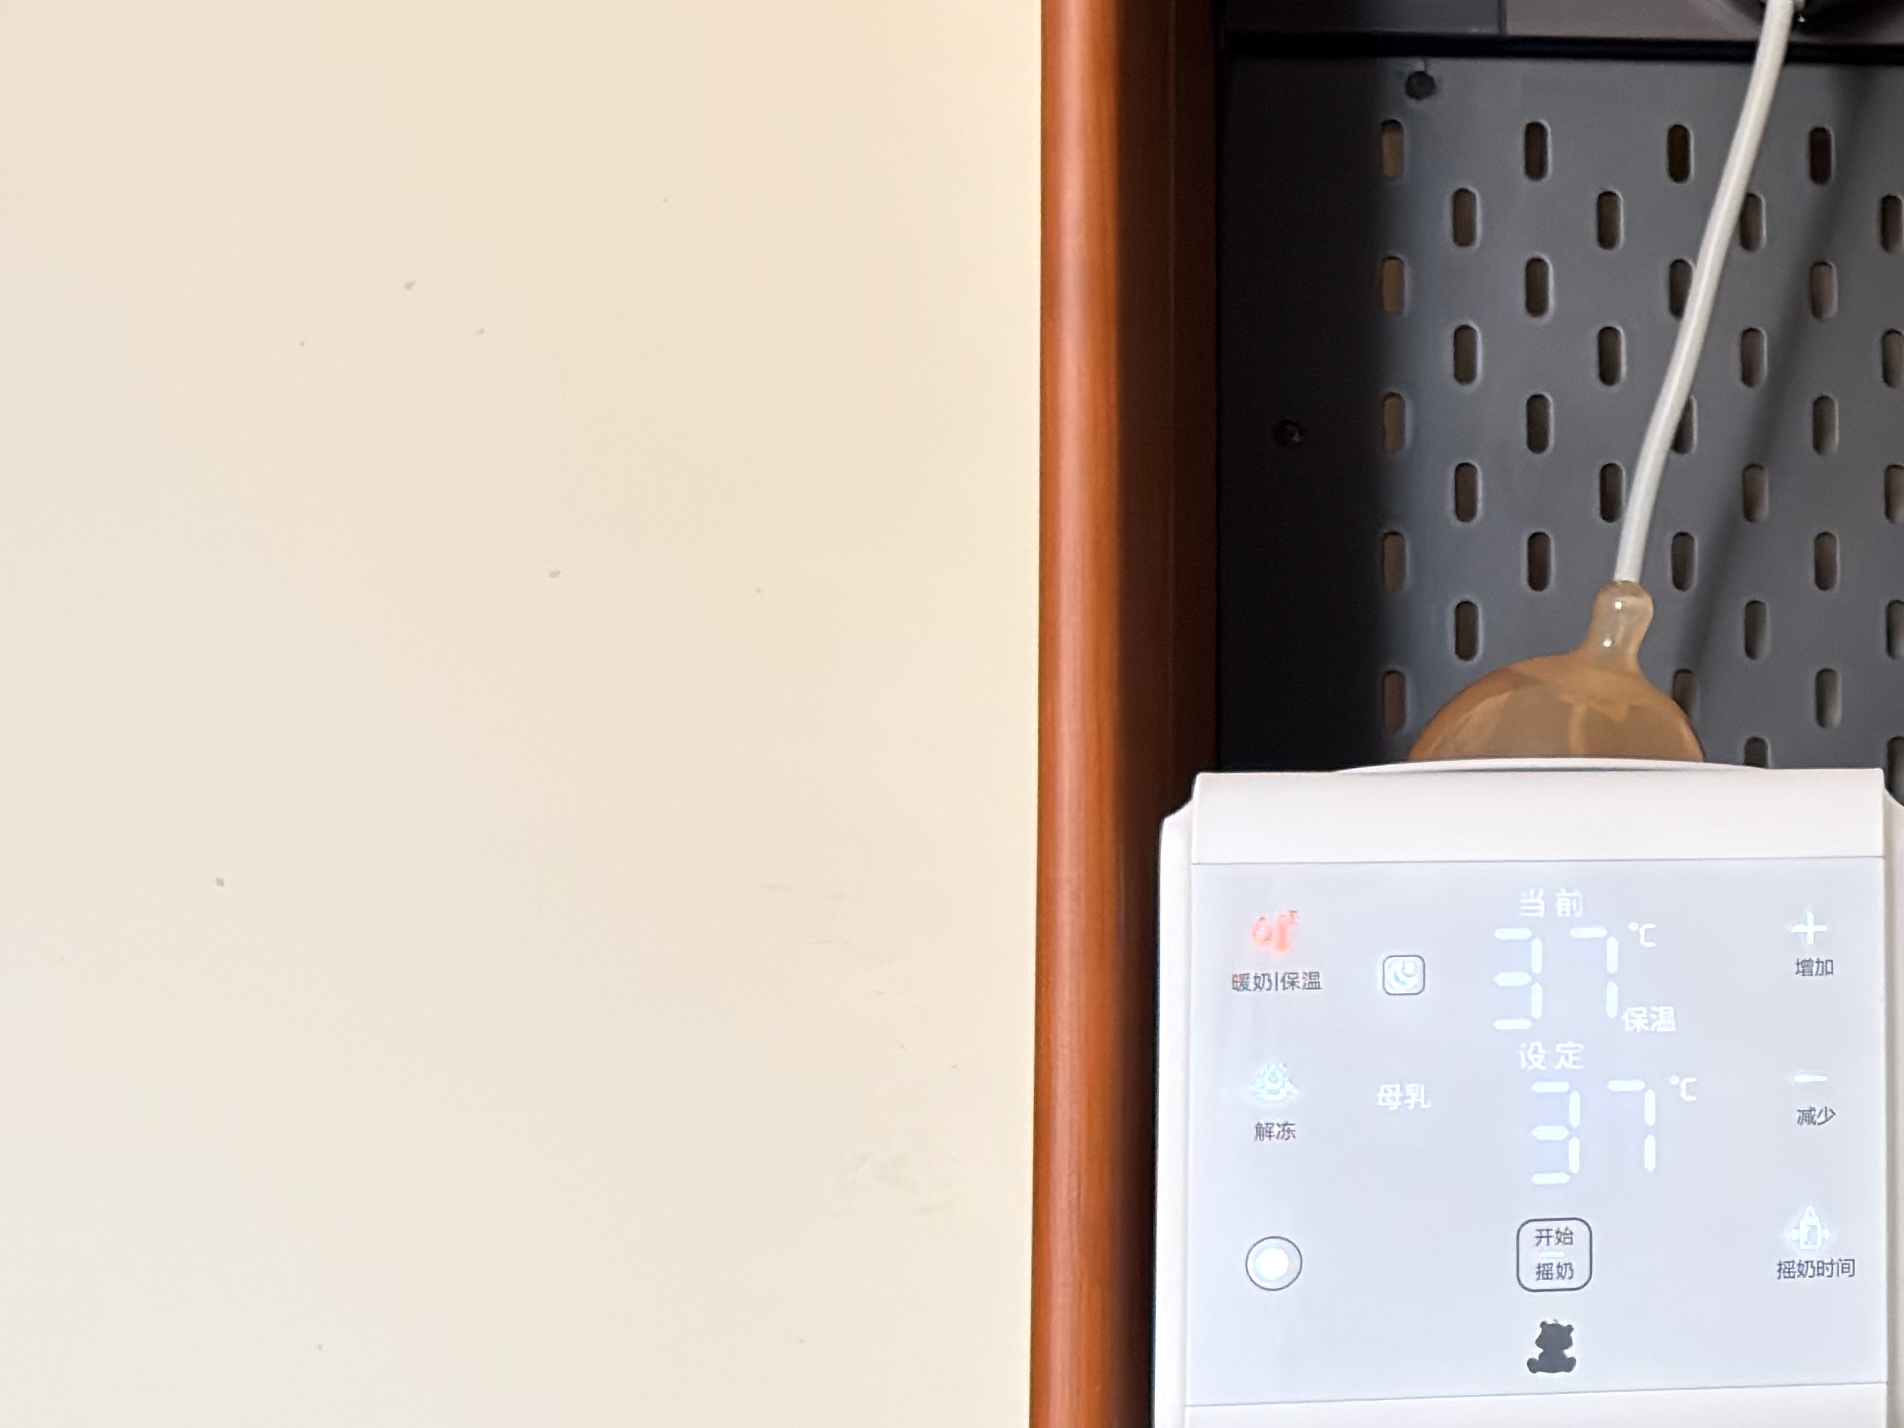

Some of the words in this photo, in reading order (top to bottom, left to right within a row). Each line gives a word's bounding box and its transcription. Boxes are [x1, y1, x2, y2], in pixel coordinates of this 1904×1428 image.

[1518, 888, 1585, 919] 当前
[1492, 926, 1620, 1031] 37
[1794, 956, 1835, 978] 增加
[1621, 1005, 1677, 1034] 保温
[1518, 1041, 1586, 1072] 设定
[1375, 1083, 1432, 1111] 母乳
[1795, 1104, 1837, 1127] 减少
[1253, 1119, 1297, 1143] 解冻
[1530, 1080, 1658, 1185] 37
[1534, 1225, 1574, 1248] 开始
[1534, 1260, 1575, 1282] 摇奶
[1776, 1257, 1856, 1280] 摇奶时间
